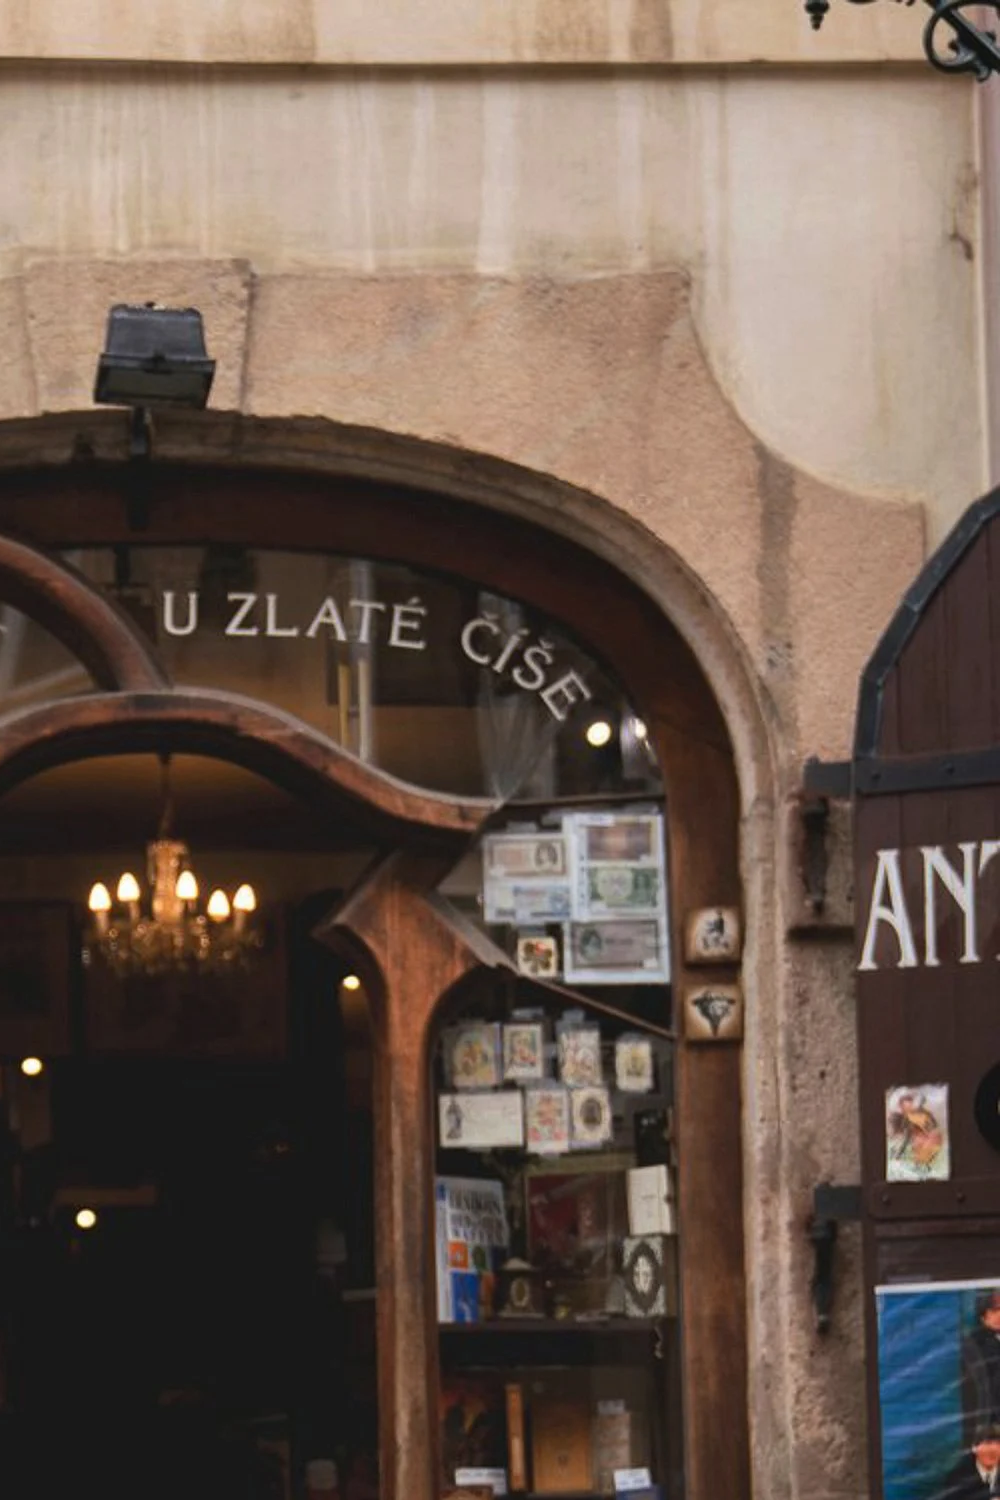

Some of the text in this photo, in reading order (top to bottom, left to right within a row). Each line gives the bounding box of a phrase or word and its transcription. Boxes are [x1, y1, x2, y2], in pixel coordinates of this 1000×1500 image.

[163, 591, 199, 636] U
[225, 592, 427, 650] ZLATÉ
[461, 610, 592, 721] ČÍŠE
